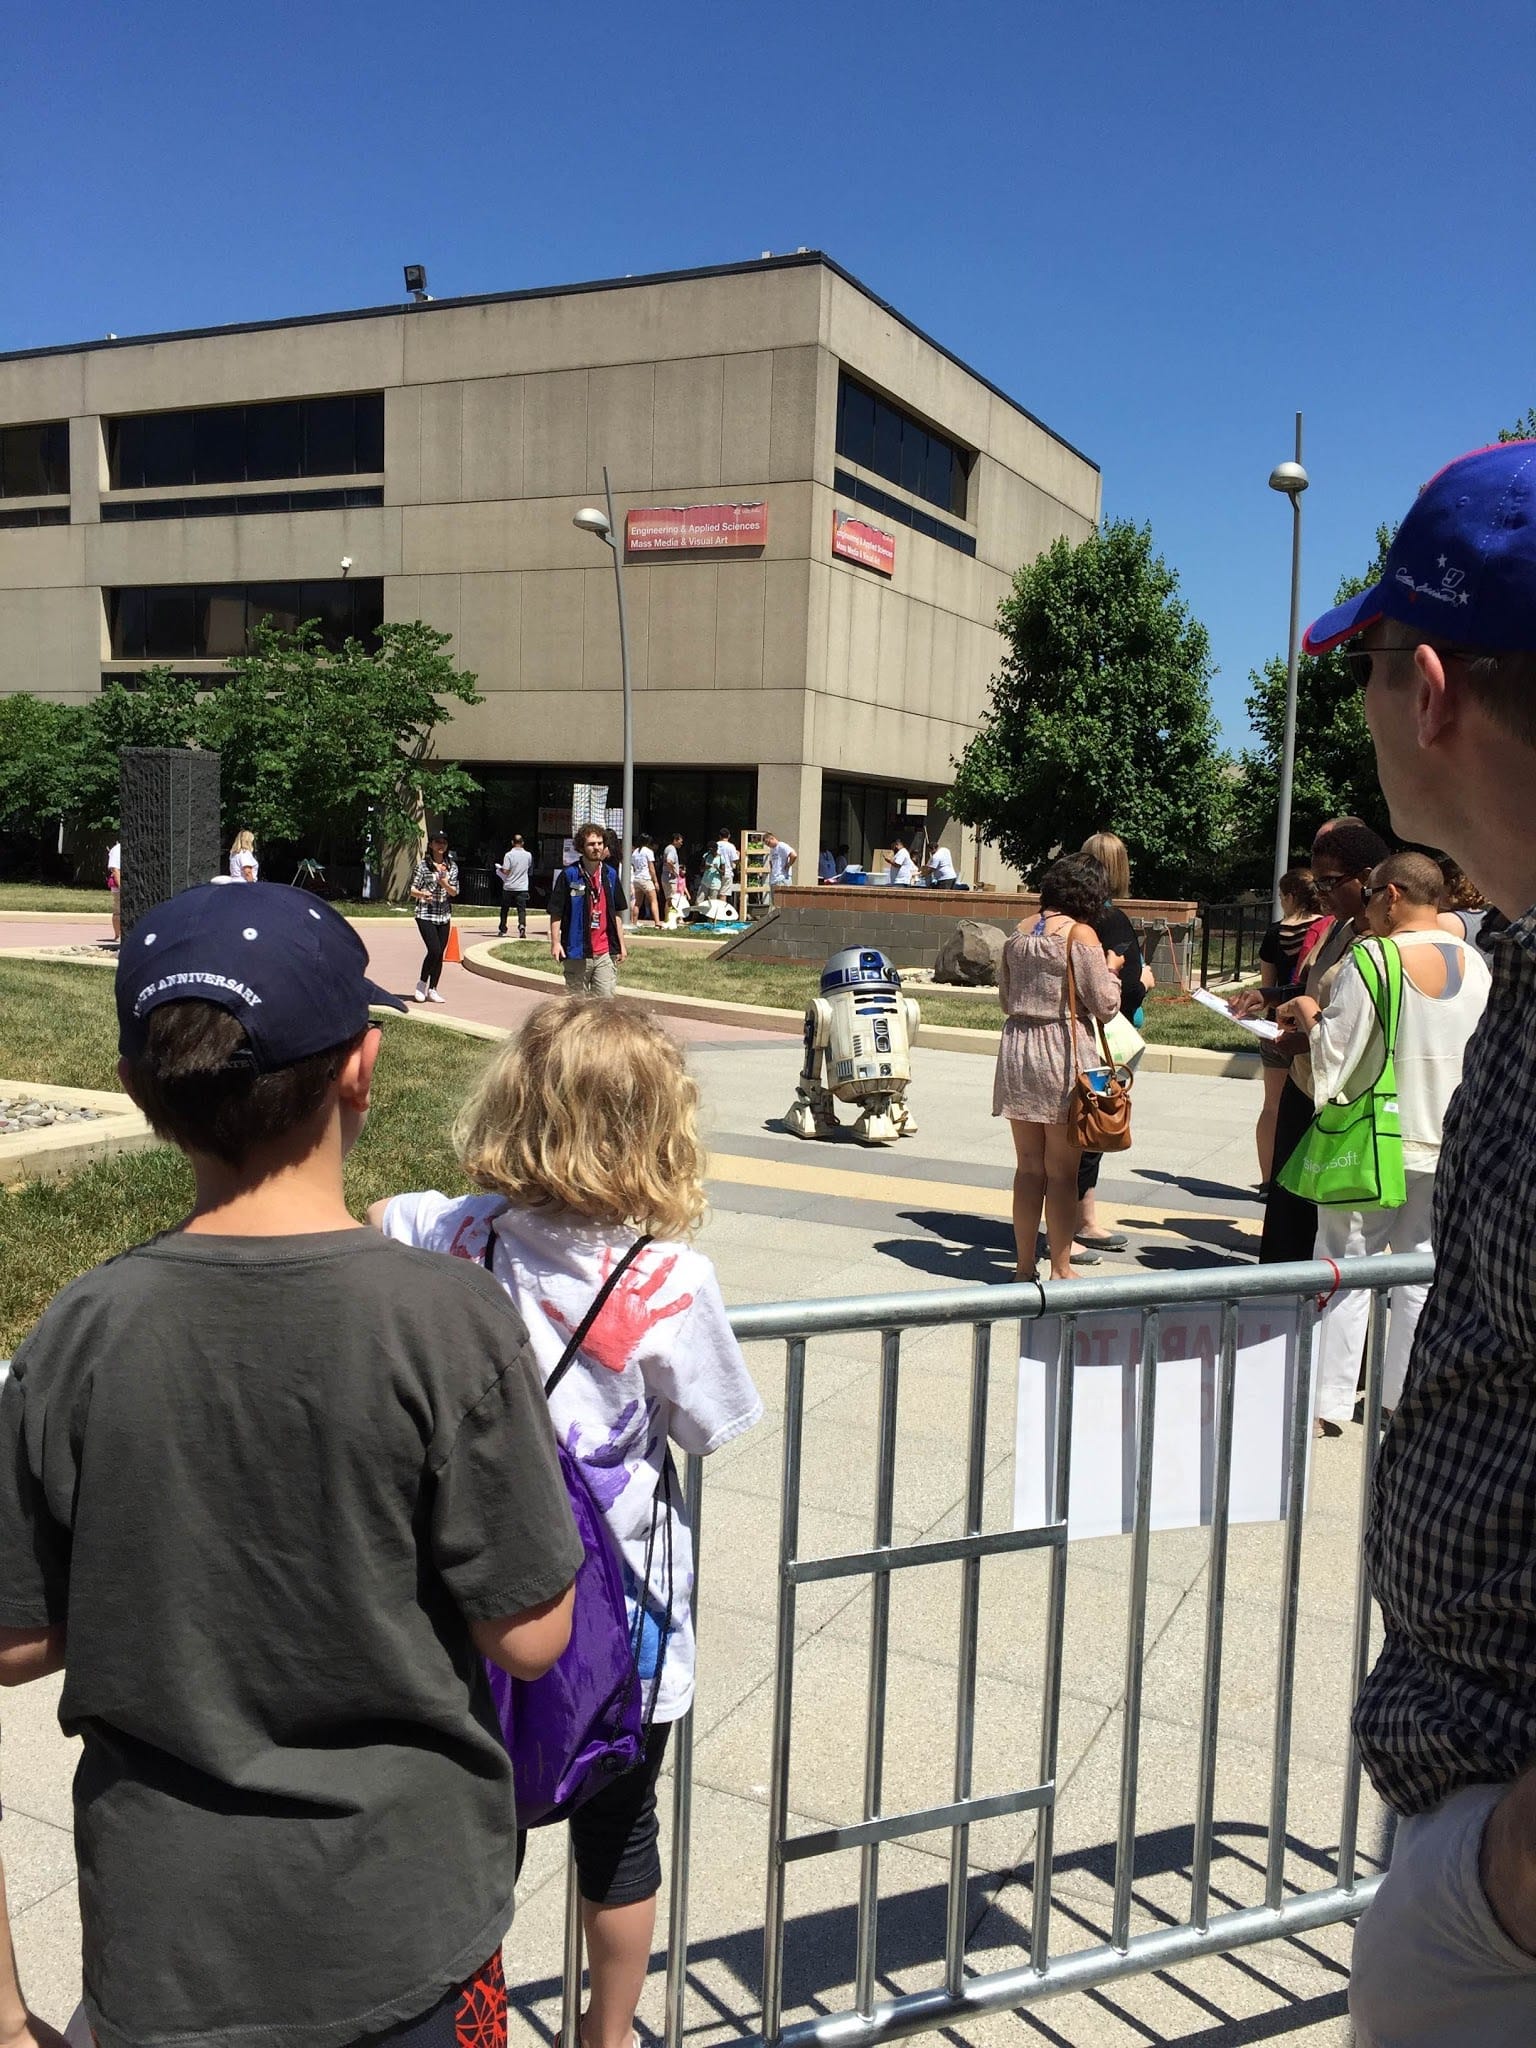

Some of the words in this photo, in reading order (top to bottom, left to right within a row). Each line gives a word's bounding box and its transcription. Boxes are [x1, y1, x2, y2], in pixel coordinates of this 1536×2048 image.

[631, 526, 679, 537] Engineering
[680, 524, 687, 533] &
[689, 523, 720, 534] Applied
[721, 522, 760, 531] Sciences
[630, 539, 653, 548] Mass
[654, 537, 679, 547] Media
[680, 537, 687, 546] &
[688, 536, 713, 546] Visual
[714, 535, 728, 545] Art
[157, 972, 262, 1007] ANNIVERSARY
